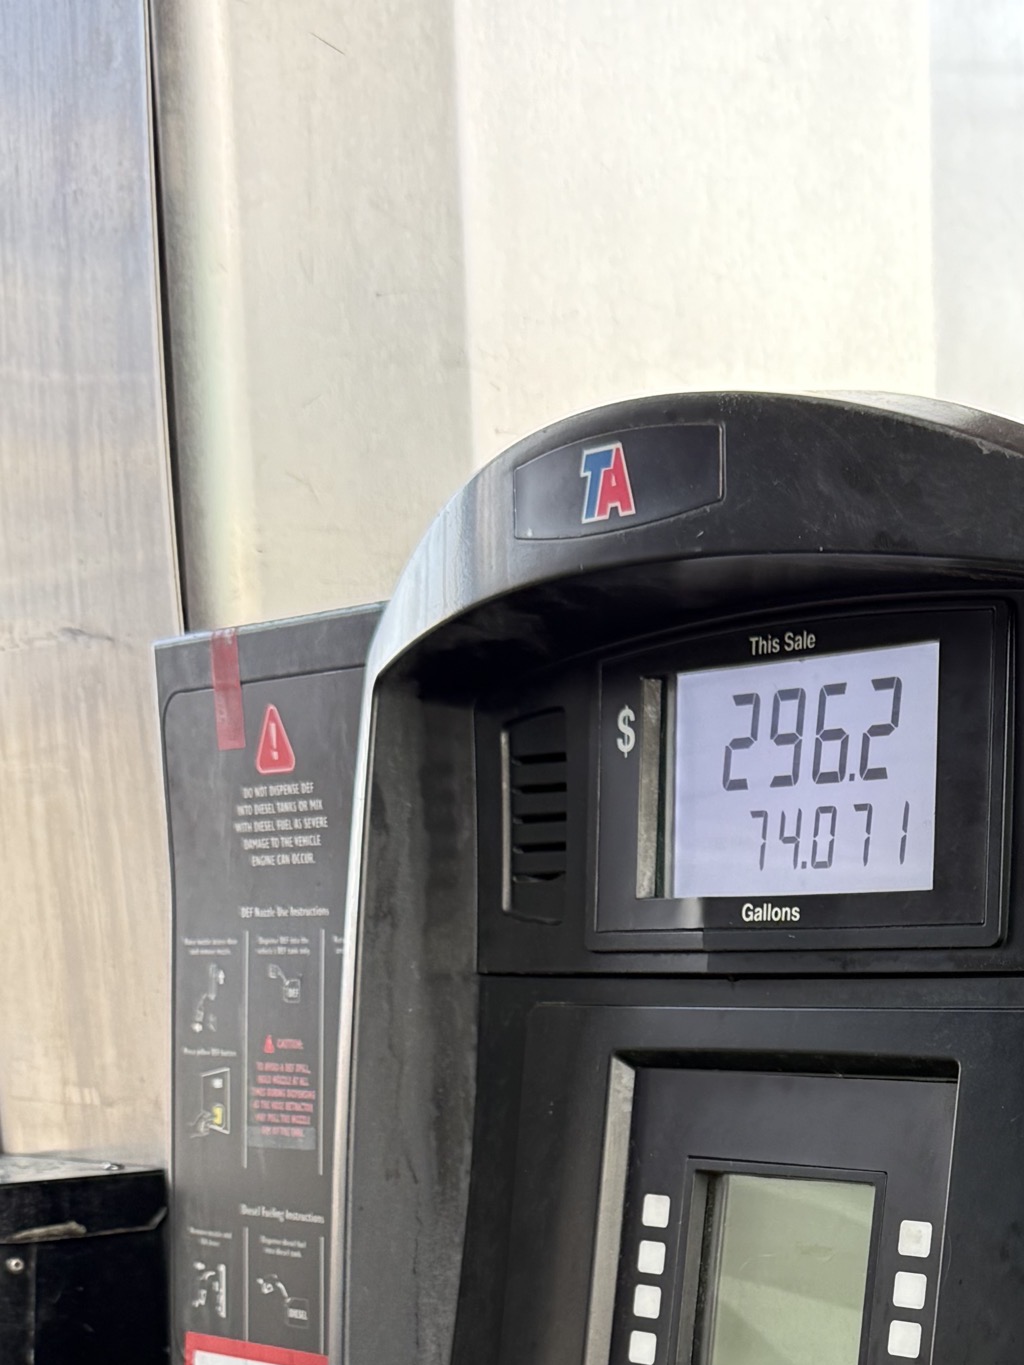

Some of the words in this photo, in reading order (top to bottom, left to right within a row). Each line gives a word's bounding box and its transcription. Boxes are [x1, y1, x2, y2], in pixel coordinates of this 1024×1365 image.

[581, 441, 636, 524] TA
[748, 635, 781, 656] This
[784, 632, 816, 653] Sale
[616, 704, 636, 758] $
[722, 675, 903, 792] 296.2
[750, 801, 910, 871] 74.071
[741, 903, 800, 924] Gallons
